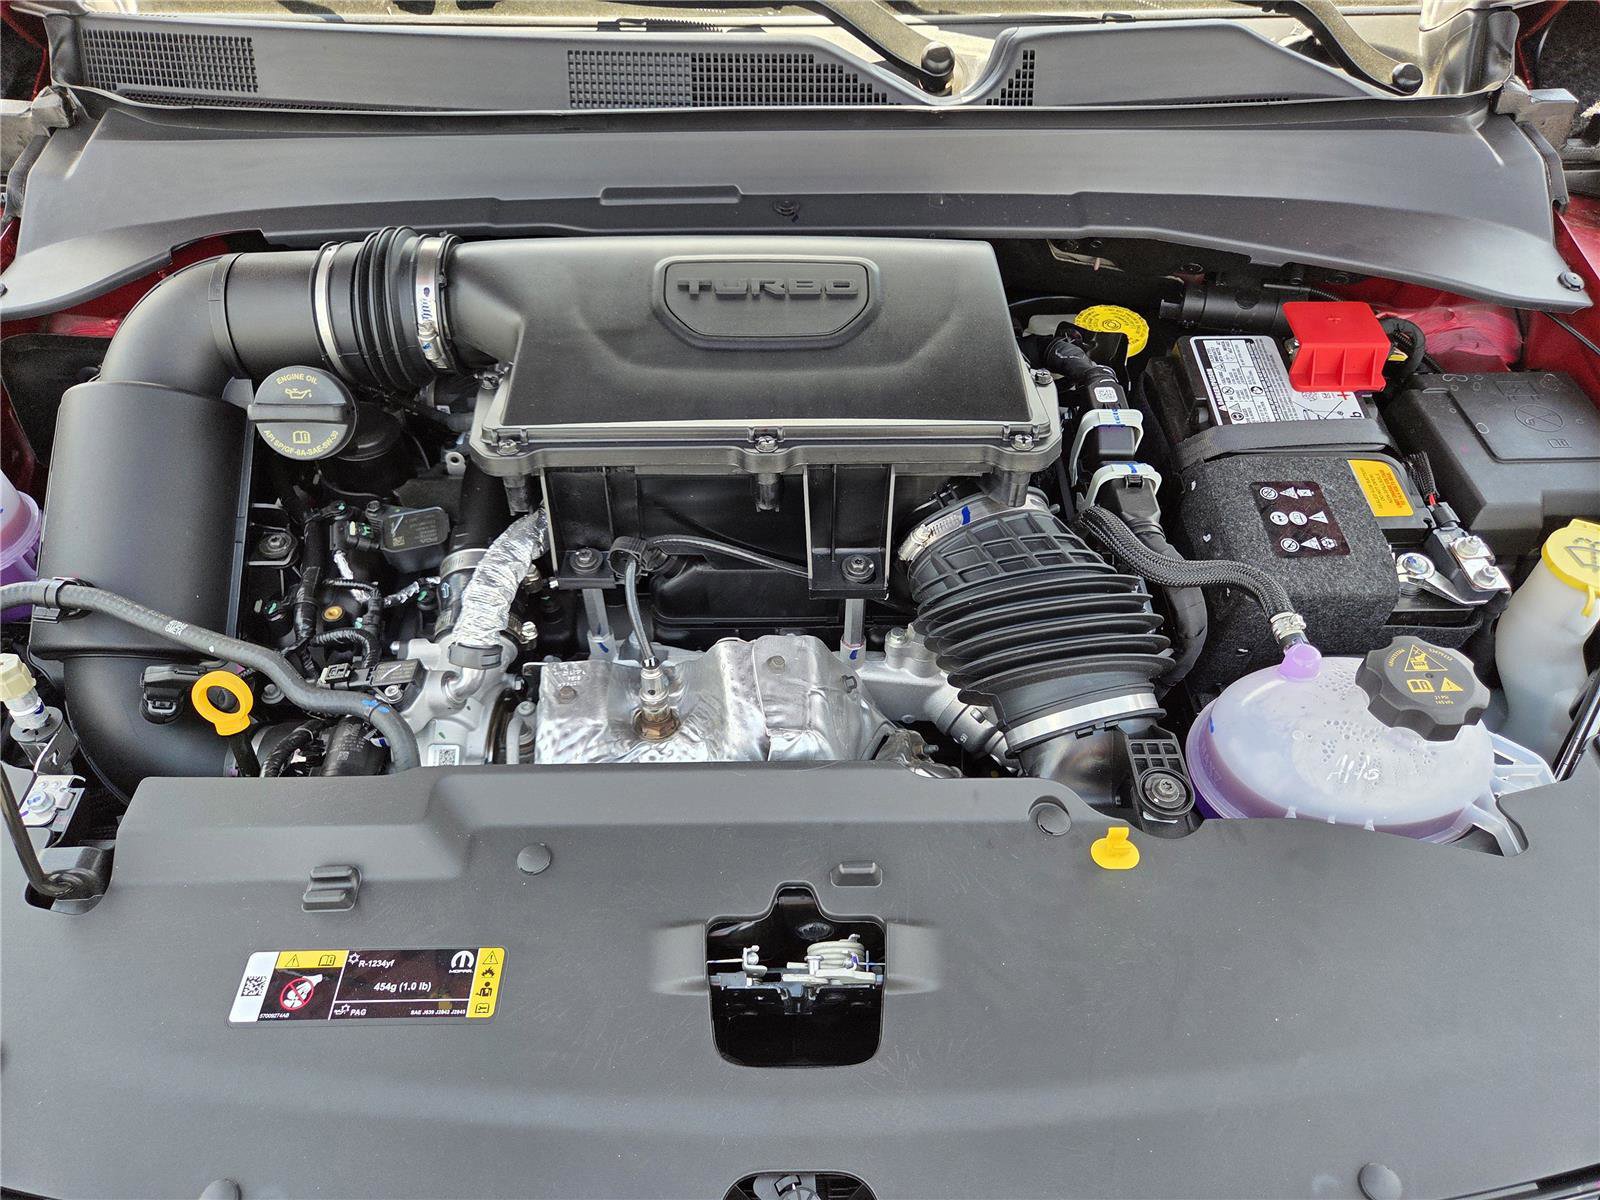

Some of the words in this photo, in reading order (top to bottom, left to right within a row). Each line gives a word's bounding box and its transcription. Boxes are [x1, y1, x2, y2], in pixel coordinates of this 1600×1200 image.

[677, 279, 858, 299] TURBO
[276, 373, 305, 385] ENGINE
[305, 374, 319, 385] OIL
[263, 430, 276, 442] API
[358, 959, 396, 968] R-1234yf
[373, 982, 397, 993] 454g
[398, 981, 417, 993] (1.0
[417, 981, 432, 992] lb)
[350, 1008, 367, 1016] PAG
